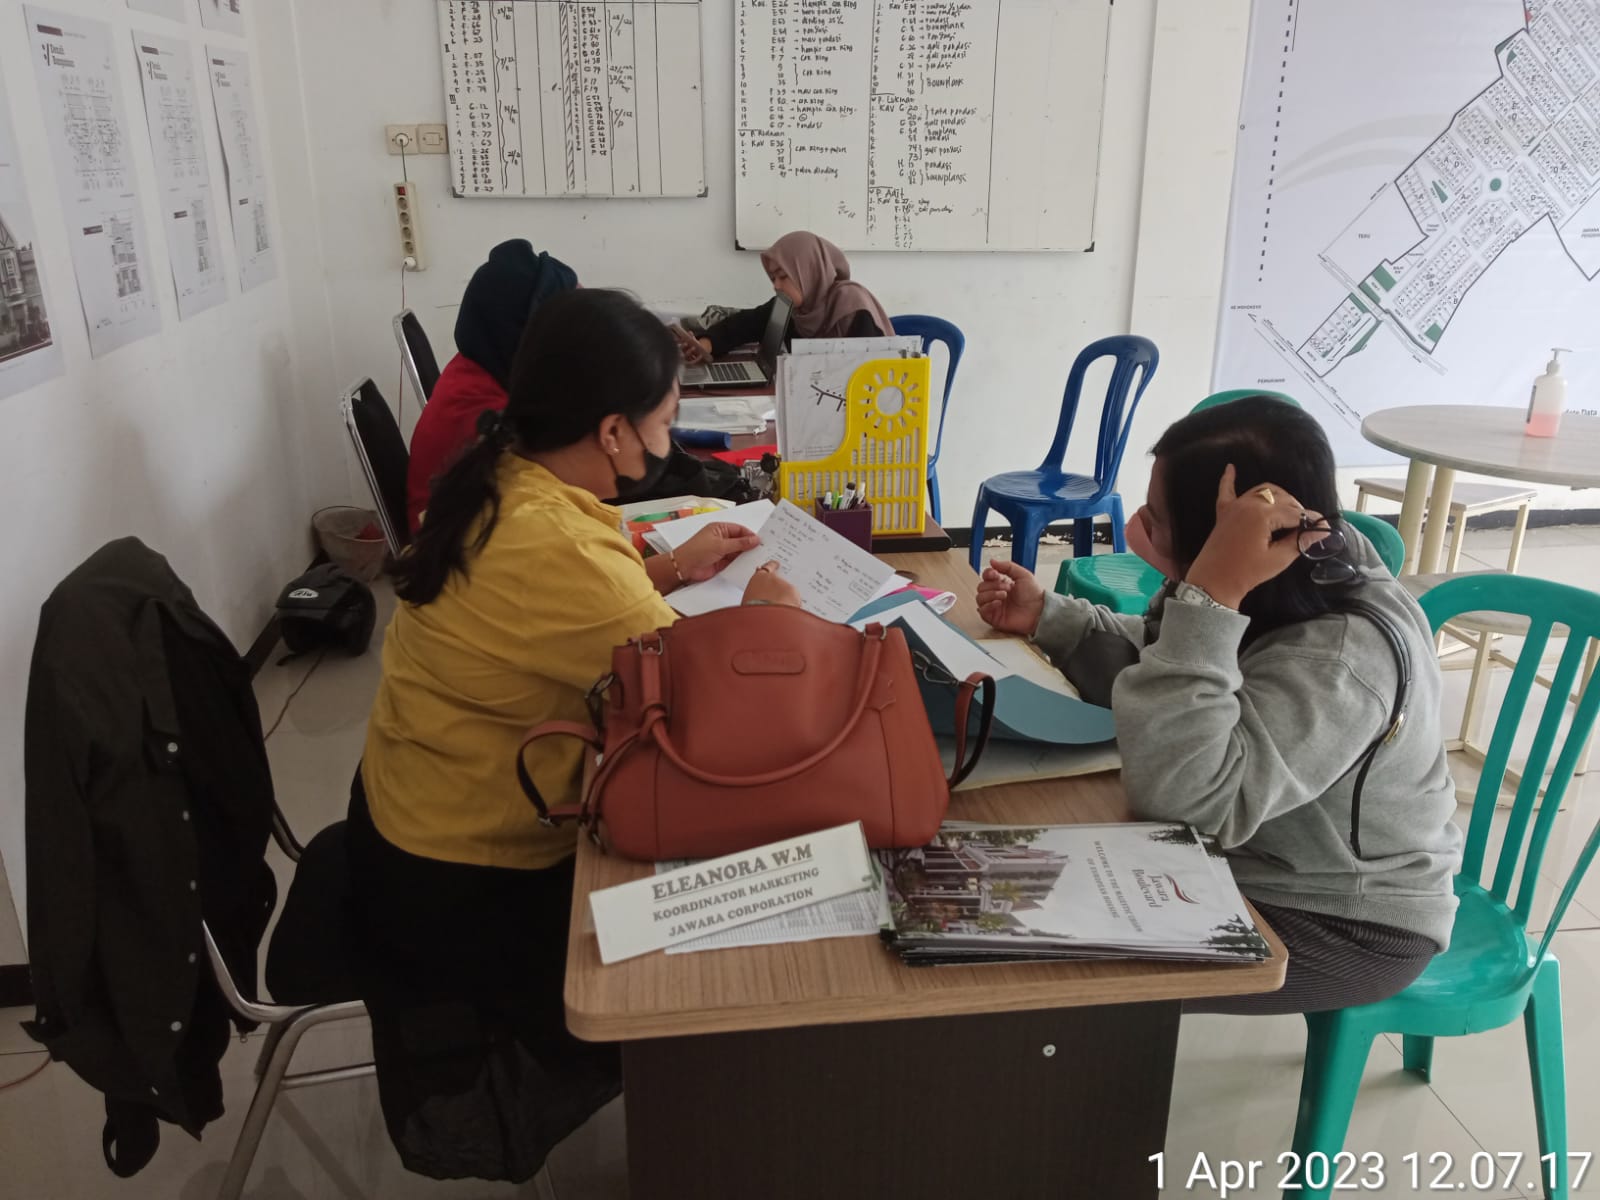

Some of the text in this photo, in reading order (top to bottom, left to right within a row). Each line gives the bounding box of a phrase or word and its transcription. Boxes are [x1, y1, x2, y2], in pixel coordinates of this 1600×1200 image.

[652, 844, 813, 899] ELEANORA W.M
[652, 868, 820, 922] KOORDINATOR MARKETING
[1132, 868, 1162, 908] Boulevard
[1150, 875, 1170, 902] Jawara
[668, 887, 814, 937] JAWARA CORPORATION
